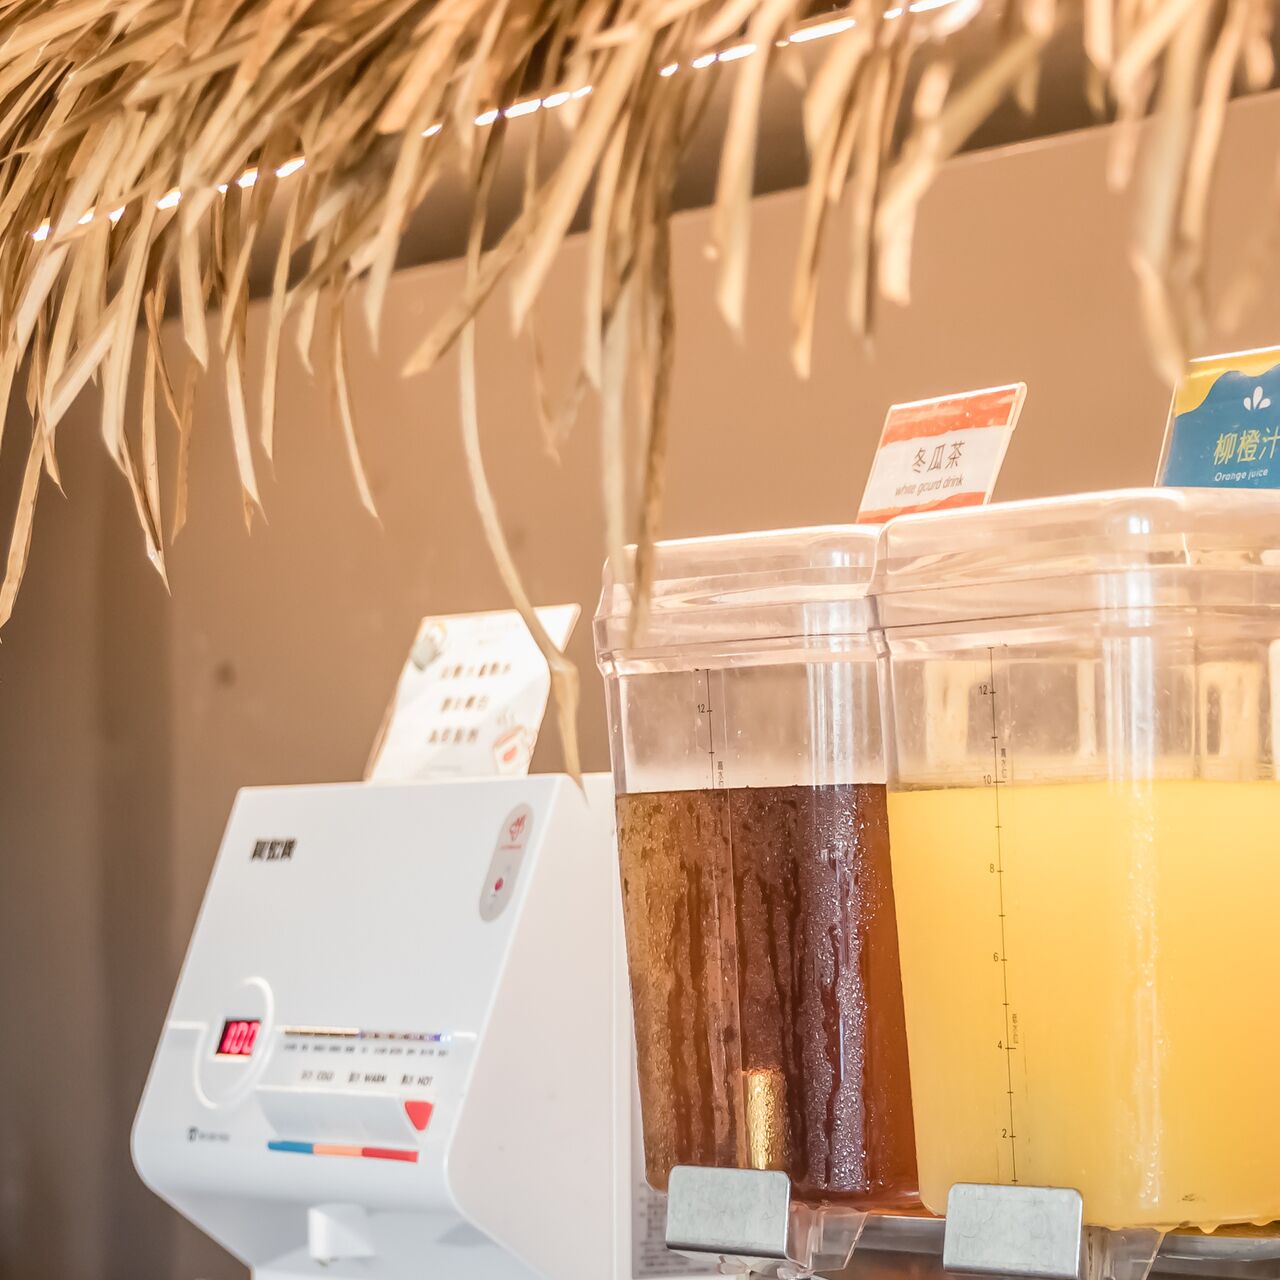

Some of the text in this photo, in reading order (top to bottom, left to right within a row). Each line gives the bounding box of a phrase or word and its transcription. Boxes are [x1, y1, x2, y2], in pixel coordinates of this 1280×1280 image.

[912, 439, 966, 473] 冬瓜茶
[1214, 468, 1269, 482] Orange juice
[978, 685, 988, 695] 12
[697, 704, 706, 713] 12
[983, 774, 992, 785] 10
[221, 1021, 261, 1055] 100
